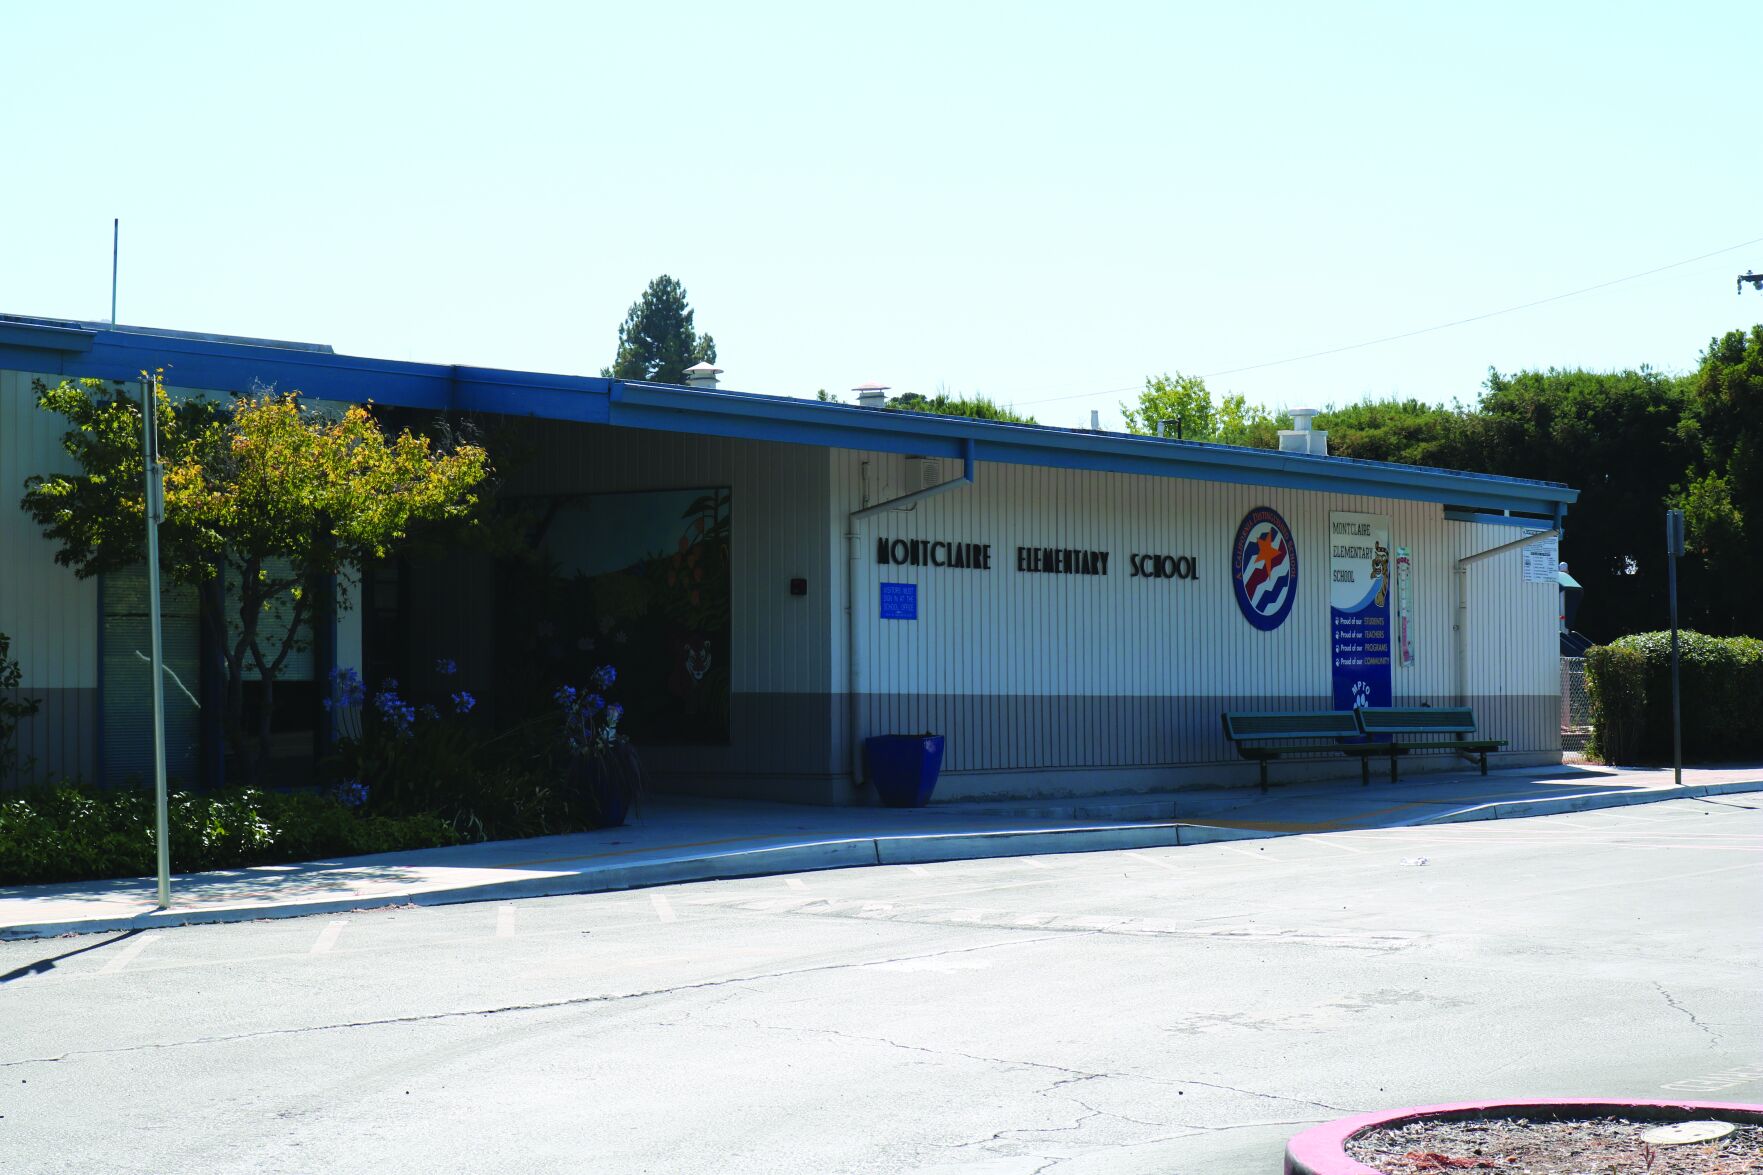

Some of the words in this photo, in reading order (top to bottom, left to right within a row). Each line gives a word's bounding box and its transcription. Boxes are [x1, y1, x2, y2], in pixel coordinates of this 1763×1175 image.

[1332, 521, 1371, 536] MONTCLAIRE
[877, 537, 991, 570] MONTCLAIRE
[1017, 546, 1110, 576] ELEMENTARY
[1129, 553, 1200, 580] SCHOOL
[1332, 545, 1374, 560] ELEMENTARY
[1332, 569, 1355, 583] SCHOOL
[1340, 617, 1351, 625] Proud
[1352, 616, 1356, 625] of
[1340, 630, 1351, 638] Proud
[1352, 630, 1356, 638] of
[1364, 630, 1384, 639] TEACHERS
[1340, 643, 1351, 652] Proud
[1352, 643, 1356, 651] of
[1364, 643, 1387, 652] PROGRAMS
[1340, 657, 1351, 665] Proud
[1352, 656, 1357, 665] of
[1352, 681, 1370, 695] MPTO
